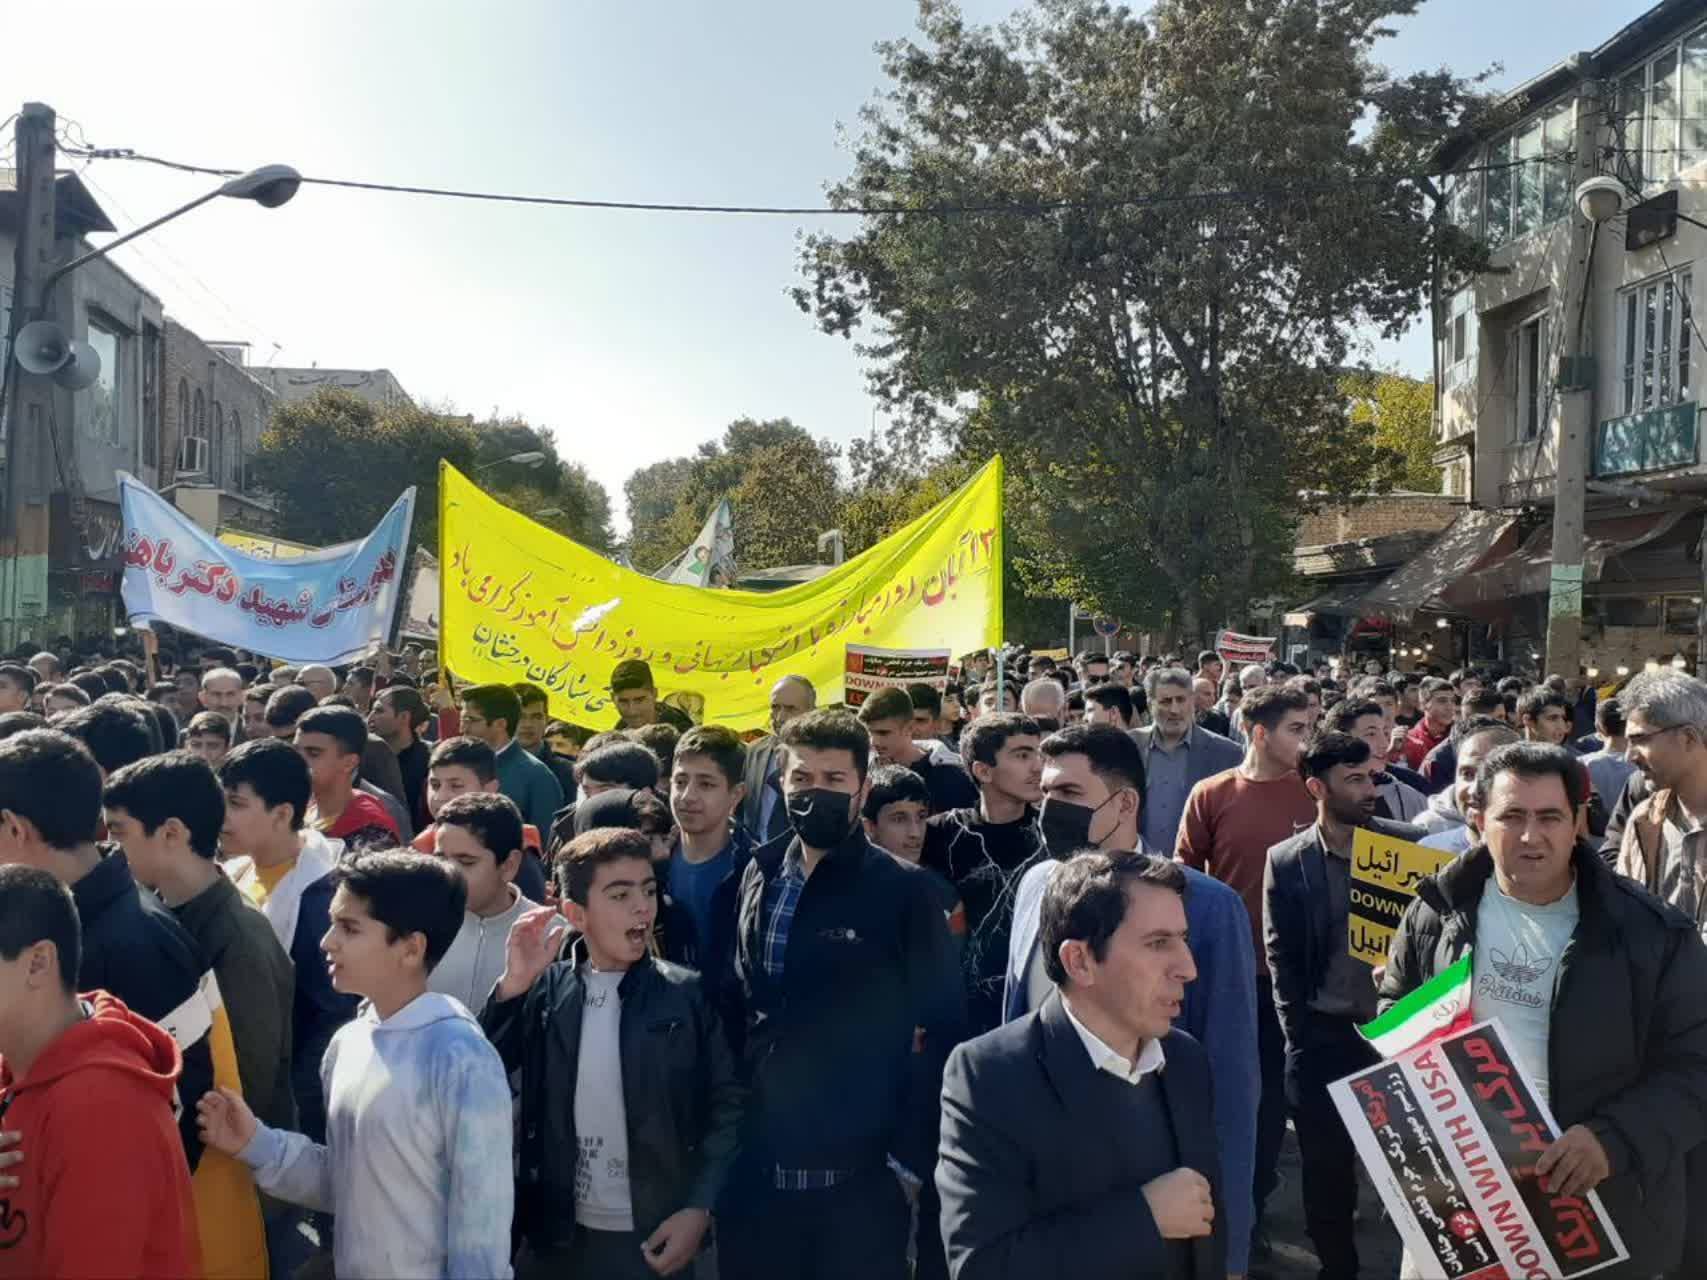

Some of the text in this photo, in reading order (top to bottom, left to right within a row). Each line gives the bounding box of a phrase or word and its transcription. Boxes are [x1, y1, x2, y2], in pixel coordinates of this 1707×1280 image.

[120, 531, 177, 586] باهن
[166, 560, 239, 605] دکتر
[450, 543, 472, 588] باد
[239, 584, 312, 628] شهید
[1350, 888, 1404, 918] DOWN
[1463, 1037, 1528, 1120] مرگ
[1509, 1121, 1551, 1152] بر
[1379, 1124, 1407, 1163] شریک
[1403, 1166, 1426, 1193] جرم
[1413, 1050, 1552, 1280] DOWN WITH USA
[1447, 1195, 1466, 1209] در
[1464, 1237, 1490, 1263] است
